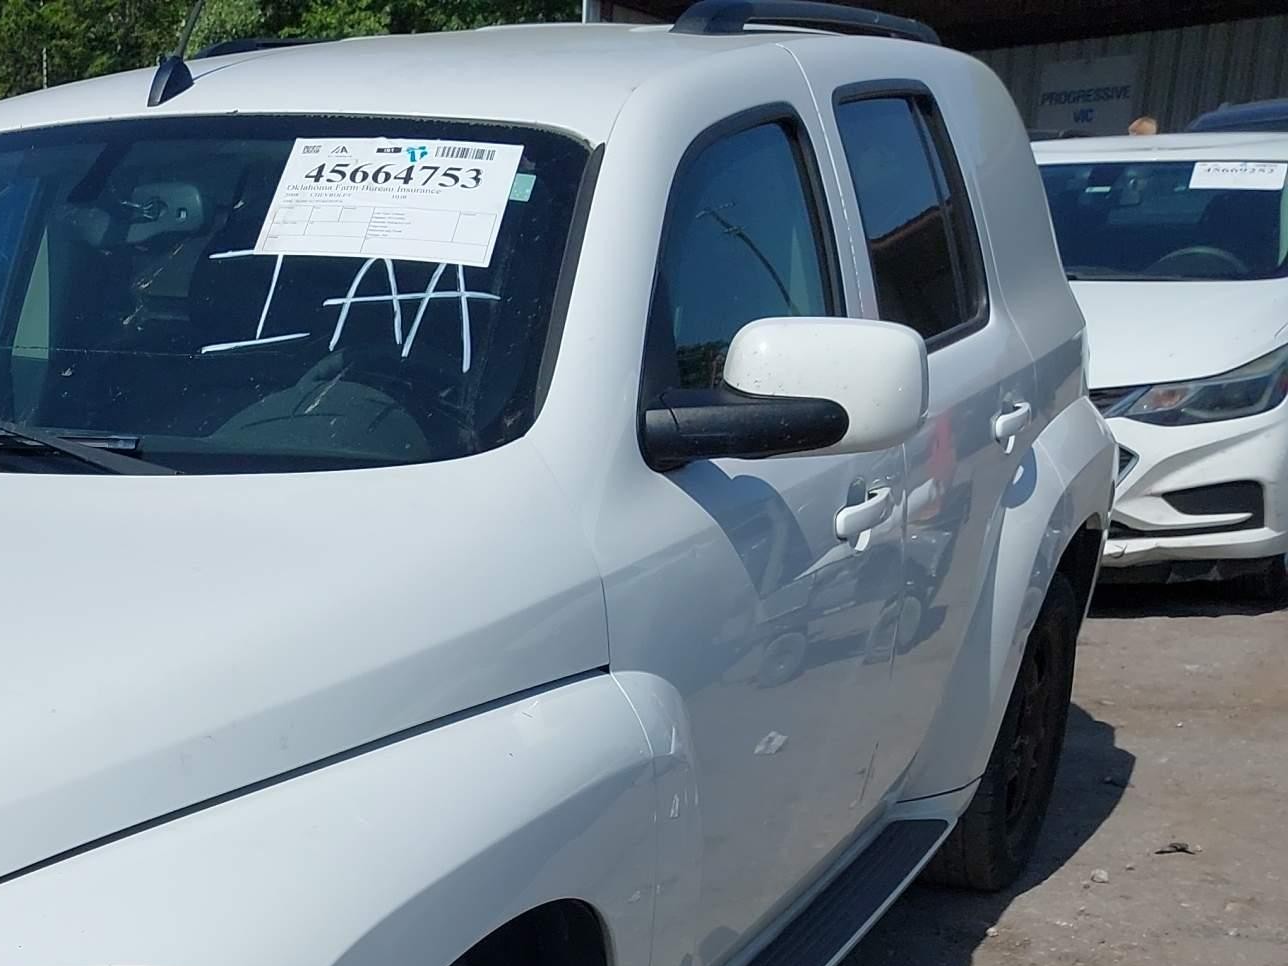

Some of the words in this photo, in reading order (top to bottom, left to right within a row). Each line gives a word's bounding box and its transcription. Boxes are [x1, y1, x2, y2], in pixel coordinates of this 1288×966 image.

[304, 163, 483, 189] 45664753
[335, 184, 359, 192] Farm
[397, 185, 442, 195] Insurance
